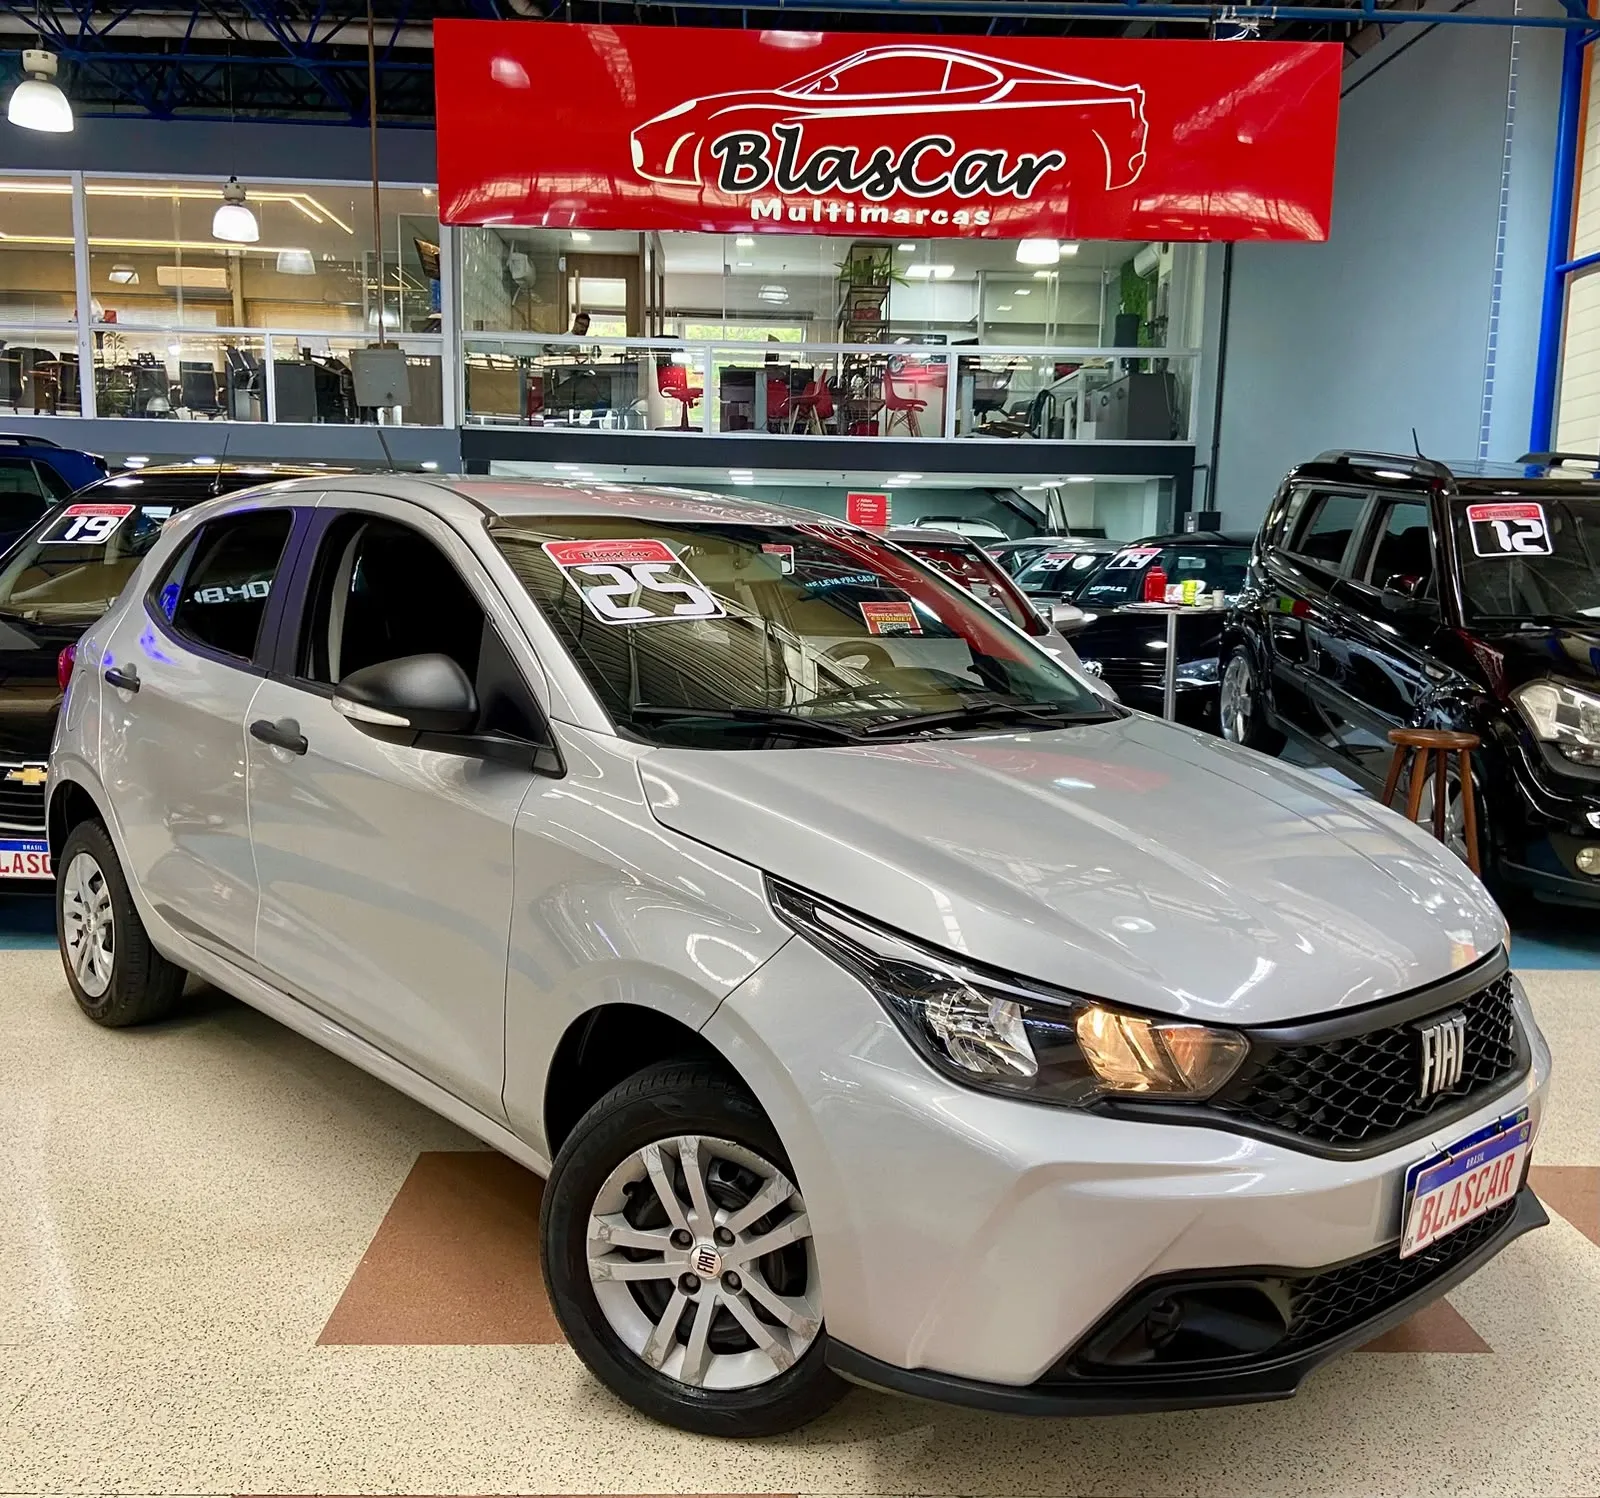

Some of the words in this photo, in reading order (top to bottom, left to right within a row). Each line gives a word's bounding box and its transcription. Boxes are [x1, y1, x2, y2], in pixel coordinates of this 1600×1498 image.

[712, 123, 1065, 199] BlasCar
[751, 199, 991, 226] Multimarcas
[64, 516, 120, 541] 19
[1491, 519, 1545, 552] 12
[1120, 555, 1151, 567] 14
[575, 564, 715, 619] 25
[818, 577, 841, 588] LEVA
[1421, 1015, 1467, 1098] FIAT
[1465, 1150, 1485, 1169] BRASIL
[1416, 1153, 1515, 1243] BLASCAR
[697, 1248, 716, 1274] FIAT
